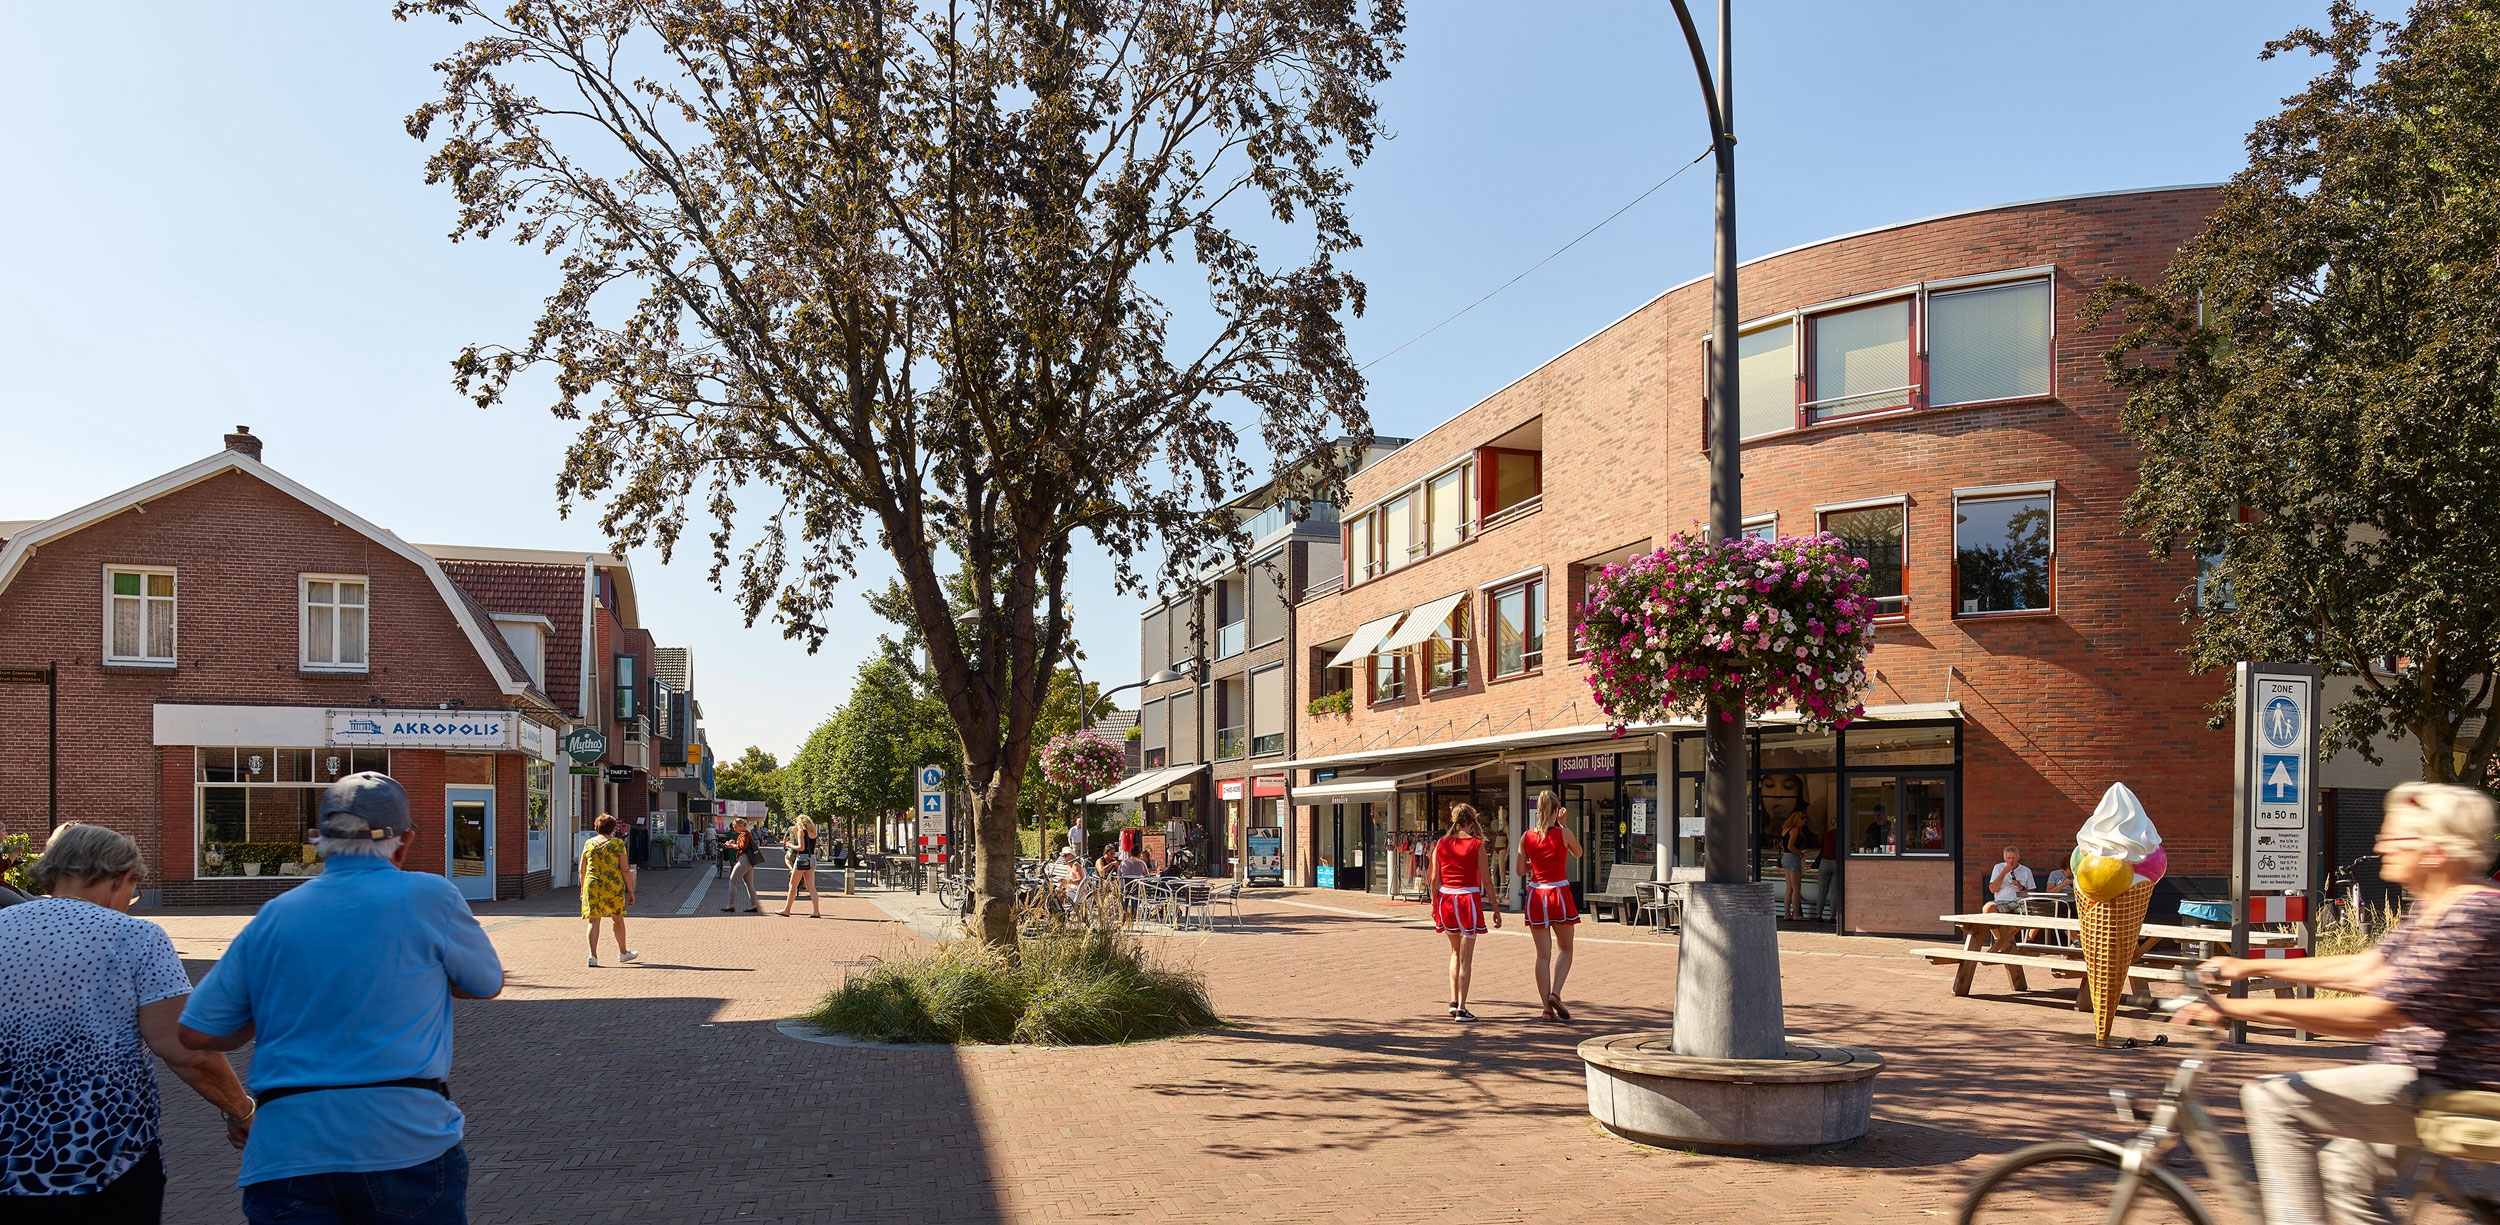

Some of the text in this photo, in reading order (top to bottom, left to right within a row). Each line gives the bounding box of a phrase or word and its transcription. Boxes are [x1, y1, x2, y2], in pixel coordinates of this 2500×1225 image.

[2272, 685, 2293, 693] ZONE
[392, 722, 499, 735] AKROPOLIS
[569, 737, 603, 753] Mythos
[1558, 753, 1615, 773] IJssalon IJstijd
[2274, 810, 2287, 819] 50
